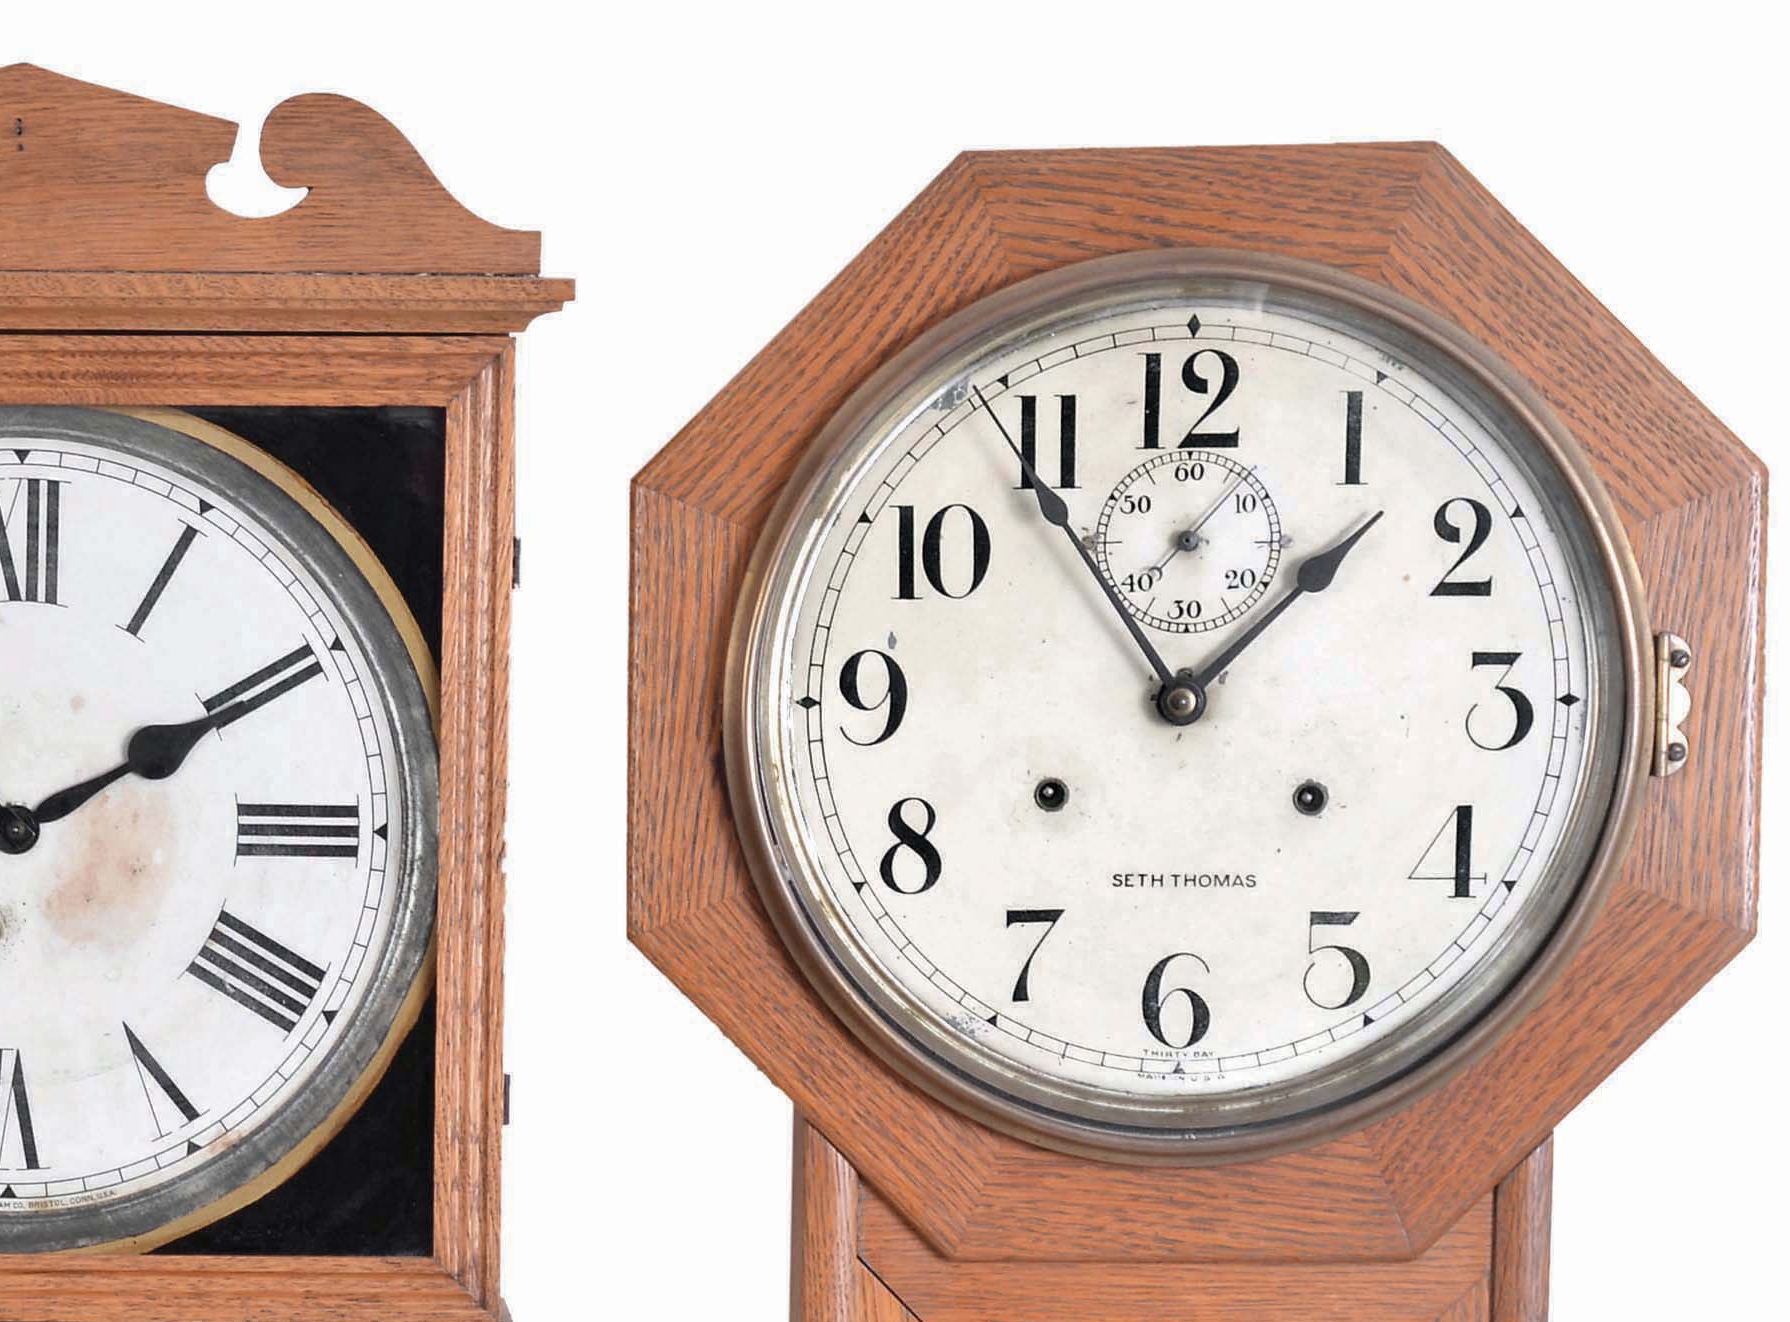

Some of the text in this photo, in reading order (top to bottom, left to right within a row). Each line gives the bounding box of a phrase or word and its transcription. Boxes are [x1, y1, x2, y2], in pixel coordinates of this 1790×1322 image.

[1012, 393, 1083, 490] 11
[1133, 348, 1241, 451] 12
[1336, 389, 1365, 487] 1
[1120, 495, 1151, 514] 50
[1174, 463, 1205, 481] 60
[1235, 494, 1256, 513] 10
[116, 518, 207, 643] I
[891, 503, 992, 602] 10
[1121, 573, 1153, 593] 40
[1225, 569, 1256, 589] 20
[1430, 497, 1495, 598] 2
[1167, 600, 1202, 619] 30
[838, 648, 909, 747] 9
[1465, 652, 1534, 752] 3
[234, 795, 360, 866] III
[878, 797, 942, 895] 8
[1407, 804, 1488, 899] 4
[1112, 874, 1257, 888] SETH THOMAS
[179, 901, 332, 1042] IIII
[1006, 908, 1066, 1003] 7
[1142, 952, 1211, 1049] 6
[1303, 911, 1371, 1010] 5
[122, 1021, 210, 1143] V
